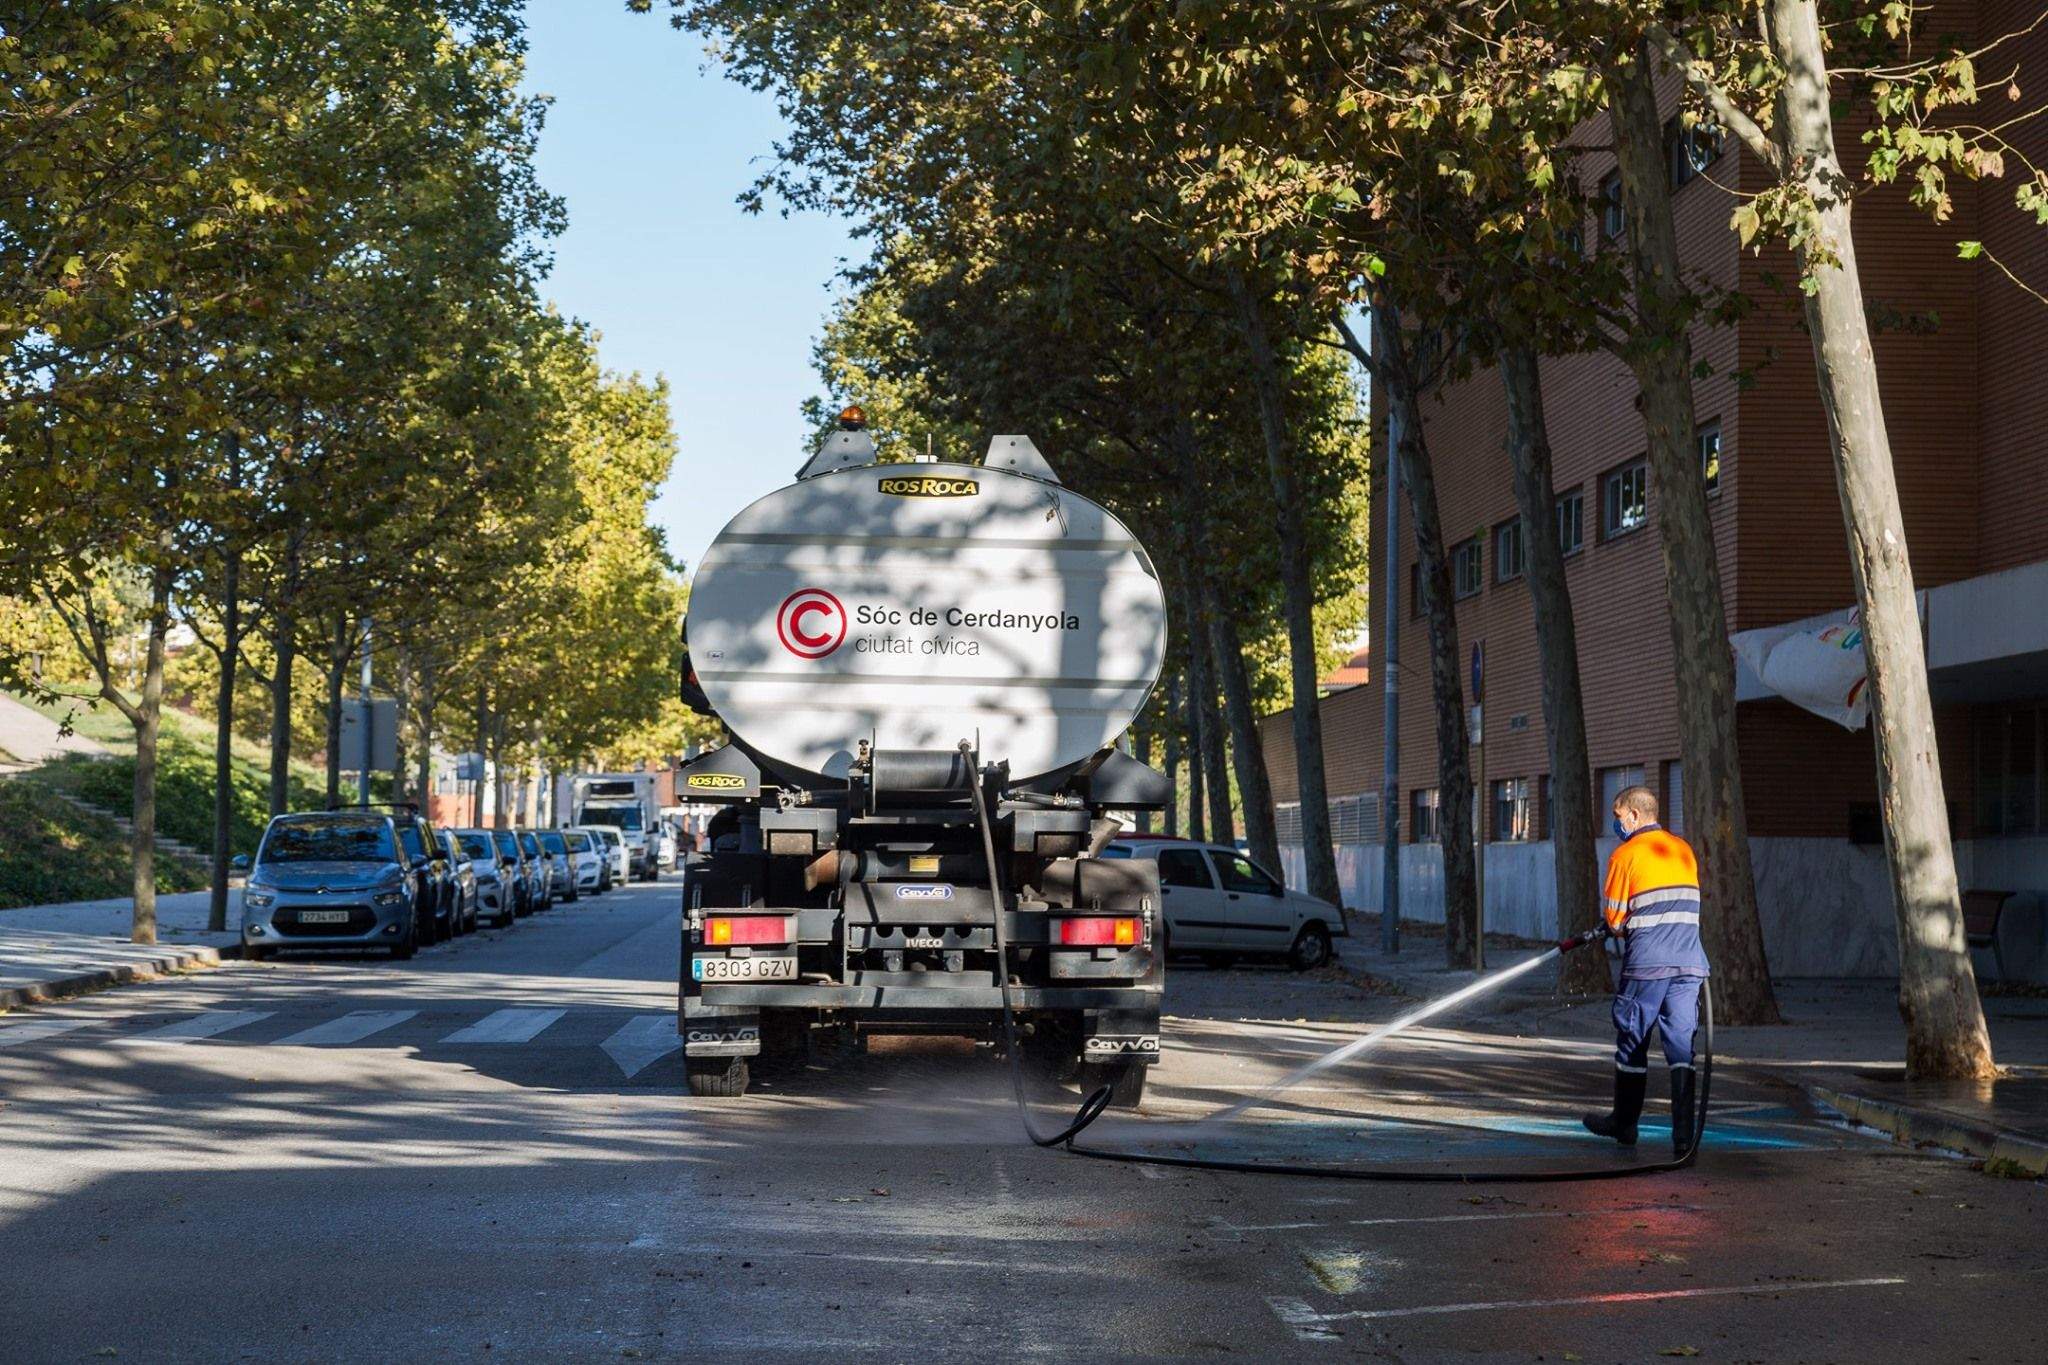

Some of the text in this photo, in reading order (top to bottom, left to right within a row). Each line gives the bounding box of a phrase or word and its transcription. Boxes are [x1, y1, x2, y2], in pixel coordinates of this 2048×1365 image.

[856, 604, 1080, 633] Sóc de Cerdanyola
[855, 633, 980, 656] ciutat cívica
[906, 938, 944, 948] IVECO
[706, 960, 793, 978] 8303 GZV
